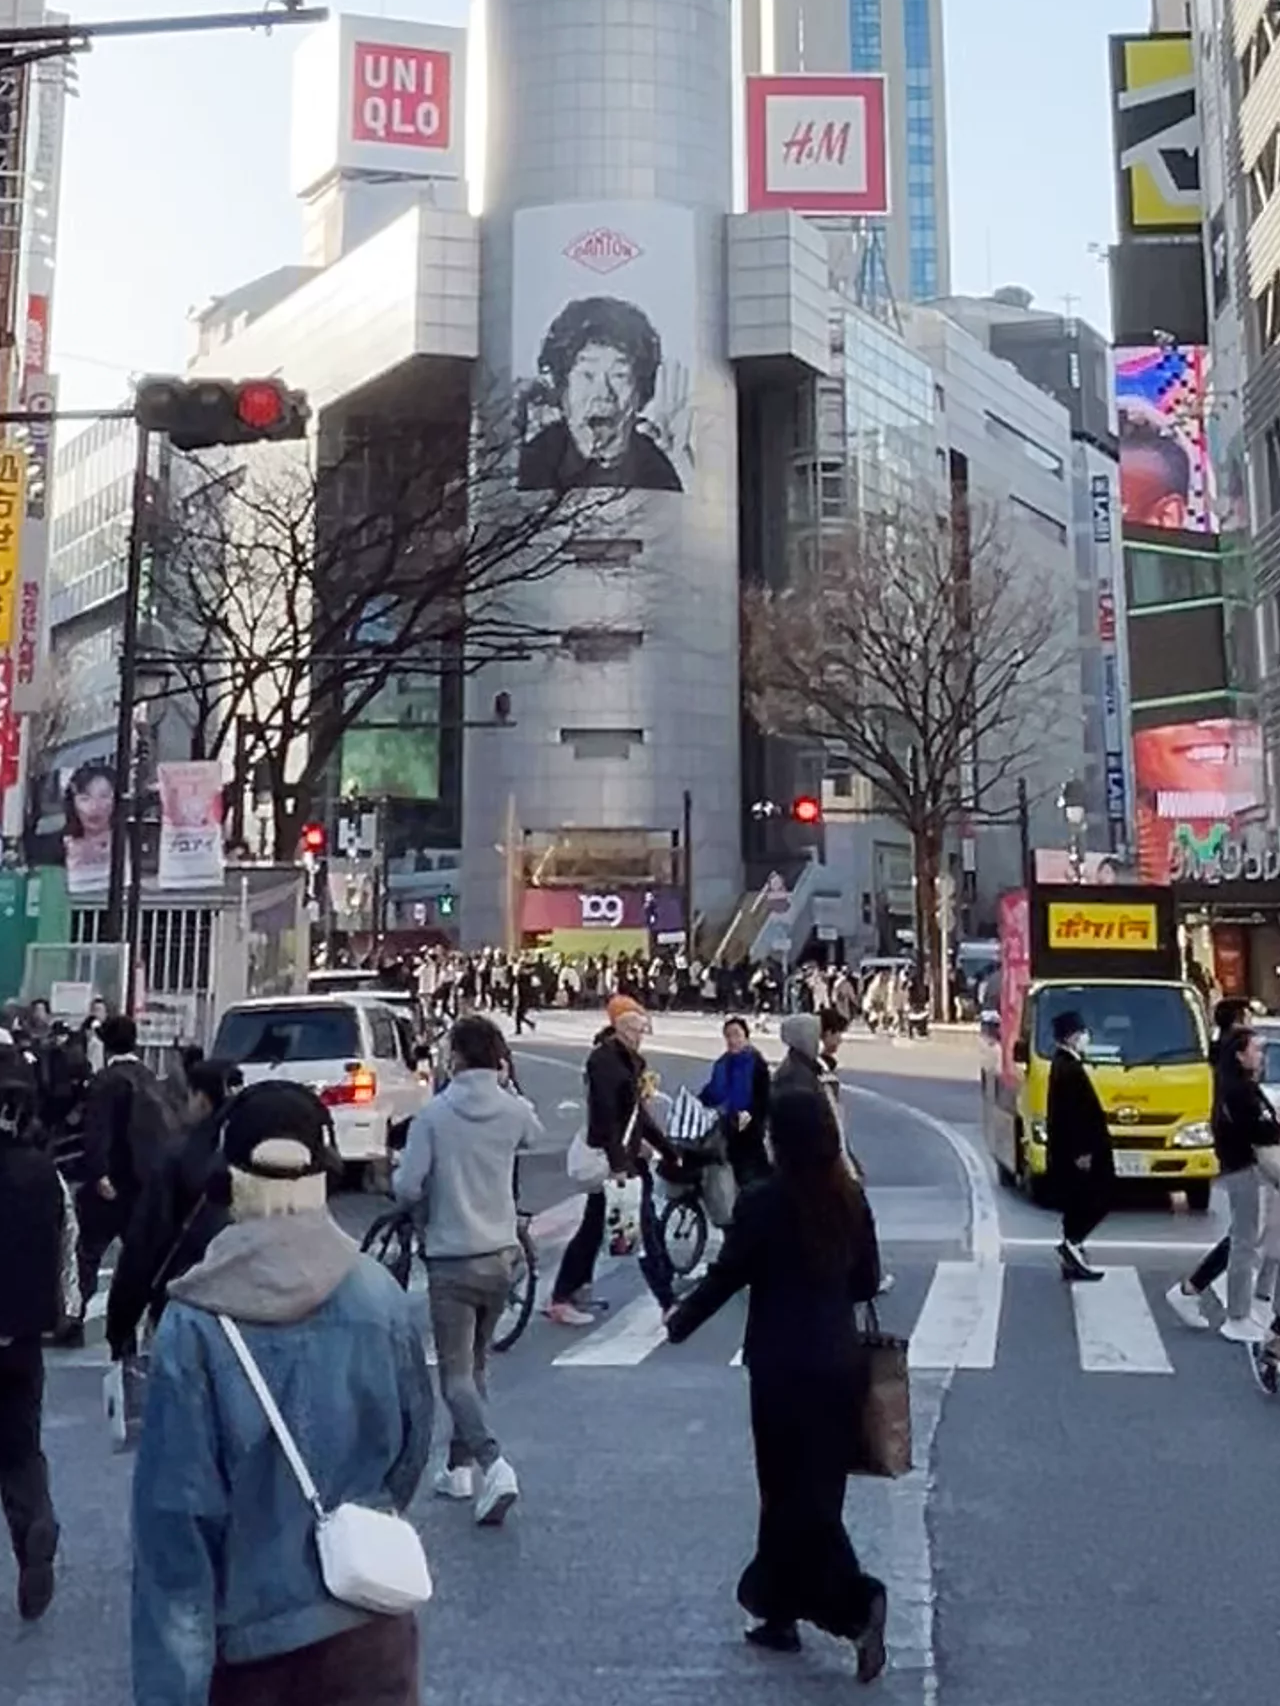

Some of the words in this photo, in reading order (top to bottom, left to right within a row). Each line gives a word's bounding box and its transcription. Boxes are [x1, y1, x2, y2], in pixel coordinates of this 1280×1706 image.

[363, 54, 435, 95] UNI
[362, 97, 440, 140] QLO
[578, 894, 624, 927] 109
